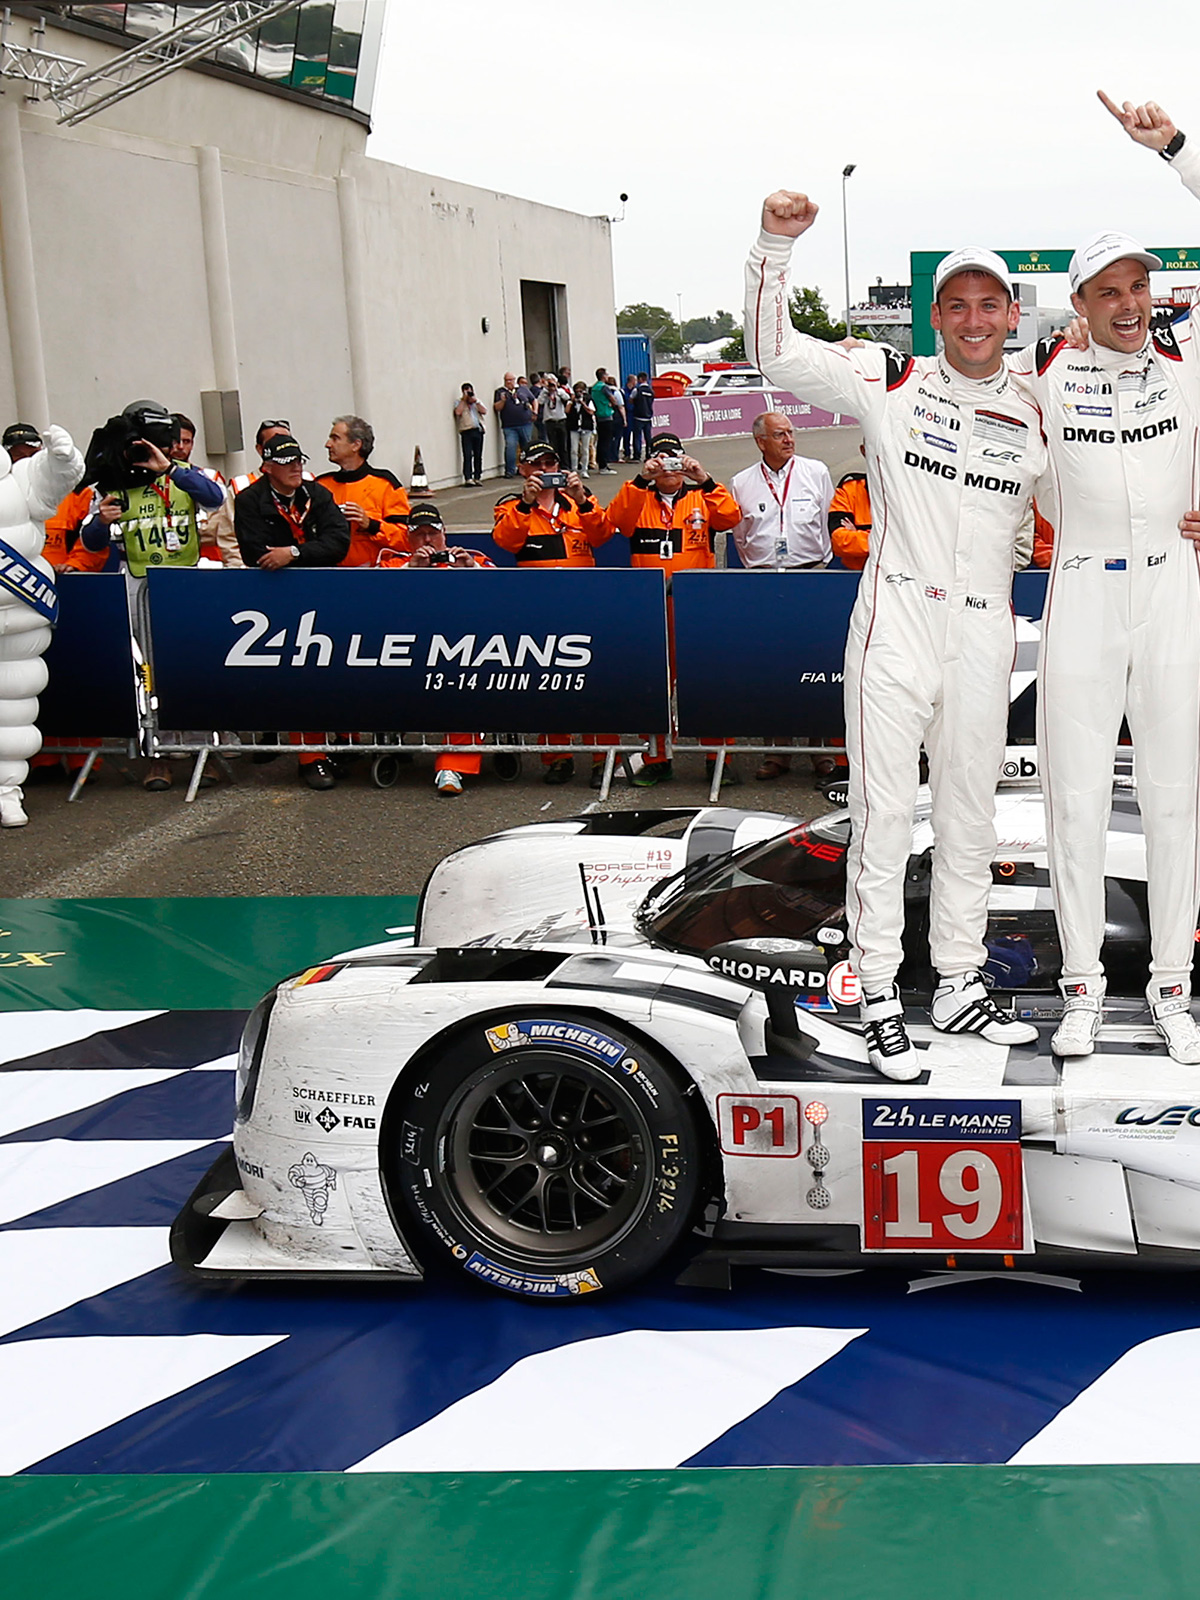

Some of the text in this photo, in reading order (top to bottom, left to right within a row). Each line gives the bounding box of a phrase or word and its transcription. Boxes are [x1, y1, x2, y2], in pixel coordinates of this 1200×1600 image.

[1018, 263, 1051, 272] ROLEX
[1166, 260, 1199, 270] ROLEX
[1064, 381, 1112, 396] Mobil 1
[1134, 389, 1169, 409] WEC
[702, 408, 742, 422] PAYS DE LA LOIRE
[913, 405, 948, 428] Mobil
[949, 418, 961, 432] 1
[1063, 416, 1179, 444] DMG MORI
[982, 447, 1023, 464] WEC
[904, 450, 1022, 496] DMG MORI
[134, 523, 190, 552] 149
[1147, 552, 1167, 568] Earl
[965, 595, 989, 611] Nick
[346, 633, 416, 668] LE
[426, 633, 593, 668] MANS
[423, 672, 586, 692] 13-14 JUIN 2015
[646, 850, 672, 862] #19
[583, 863, 672, 872] PORSCHE
[709, 956, 826, 988] CHOPARD
[841, 975, 857, 996] E
[531, 1025, 620, 1058] MICHELIN
[292, 1087, 376, 1106] SCHAEFFLER
[343, 1116, 376, 1130] FAG
[731, 1105, 785, 1147] P1
[872, 1105, 1013, 1128] 24h LE MANS
[1129, 1128, 1179, 1136] ENDURANCE
[237, 1157, 264, 1179] MORI
[882, 1149, 1004, 1241] 19
[469, 1261, 558, 1293] MICHELIN
